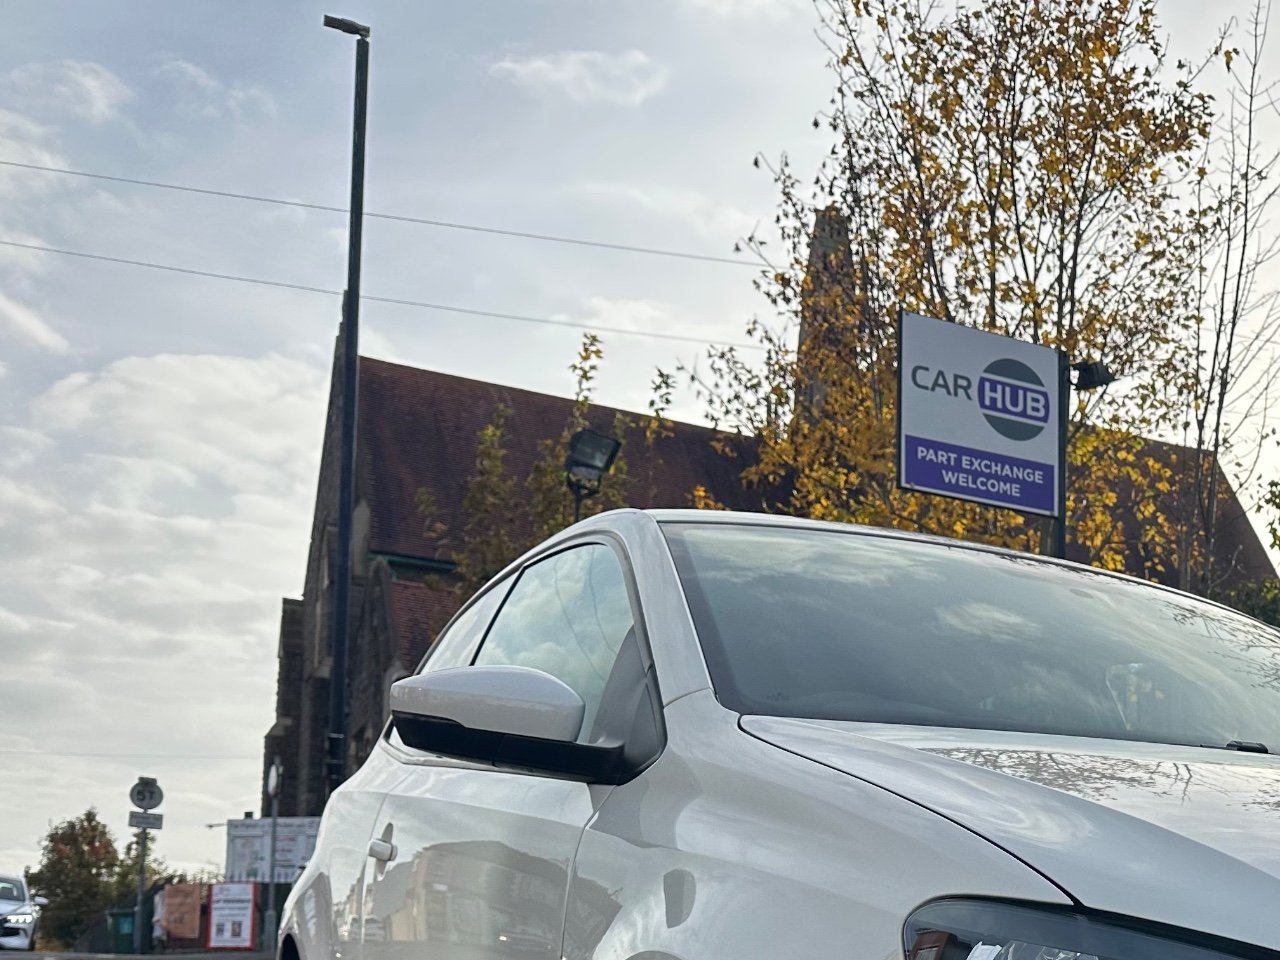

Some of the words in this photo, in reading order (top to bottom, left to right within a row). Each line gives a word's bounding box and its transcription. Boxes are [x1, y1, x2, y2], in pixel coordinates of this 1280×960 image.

[911, 365, 973, 400] CAR
[984, 382, 1046, 418] HUB
[917, 446, 957, 466] PART
[962, 456, 1043, 484] EXCHANGE
[941, 469, 1021, 497] WELCOME
